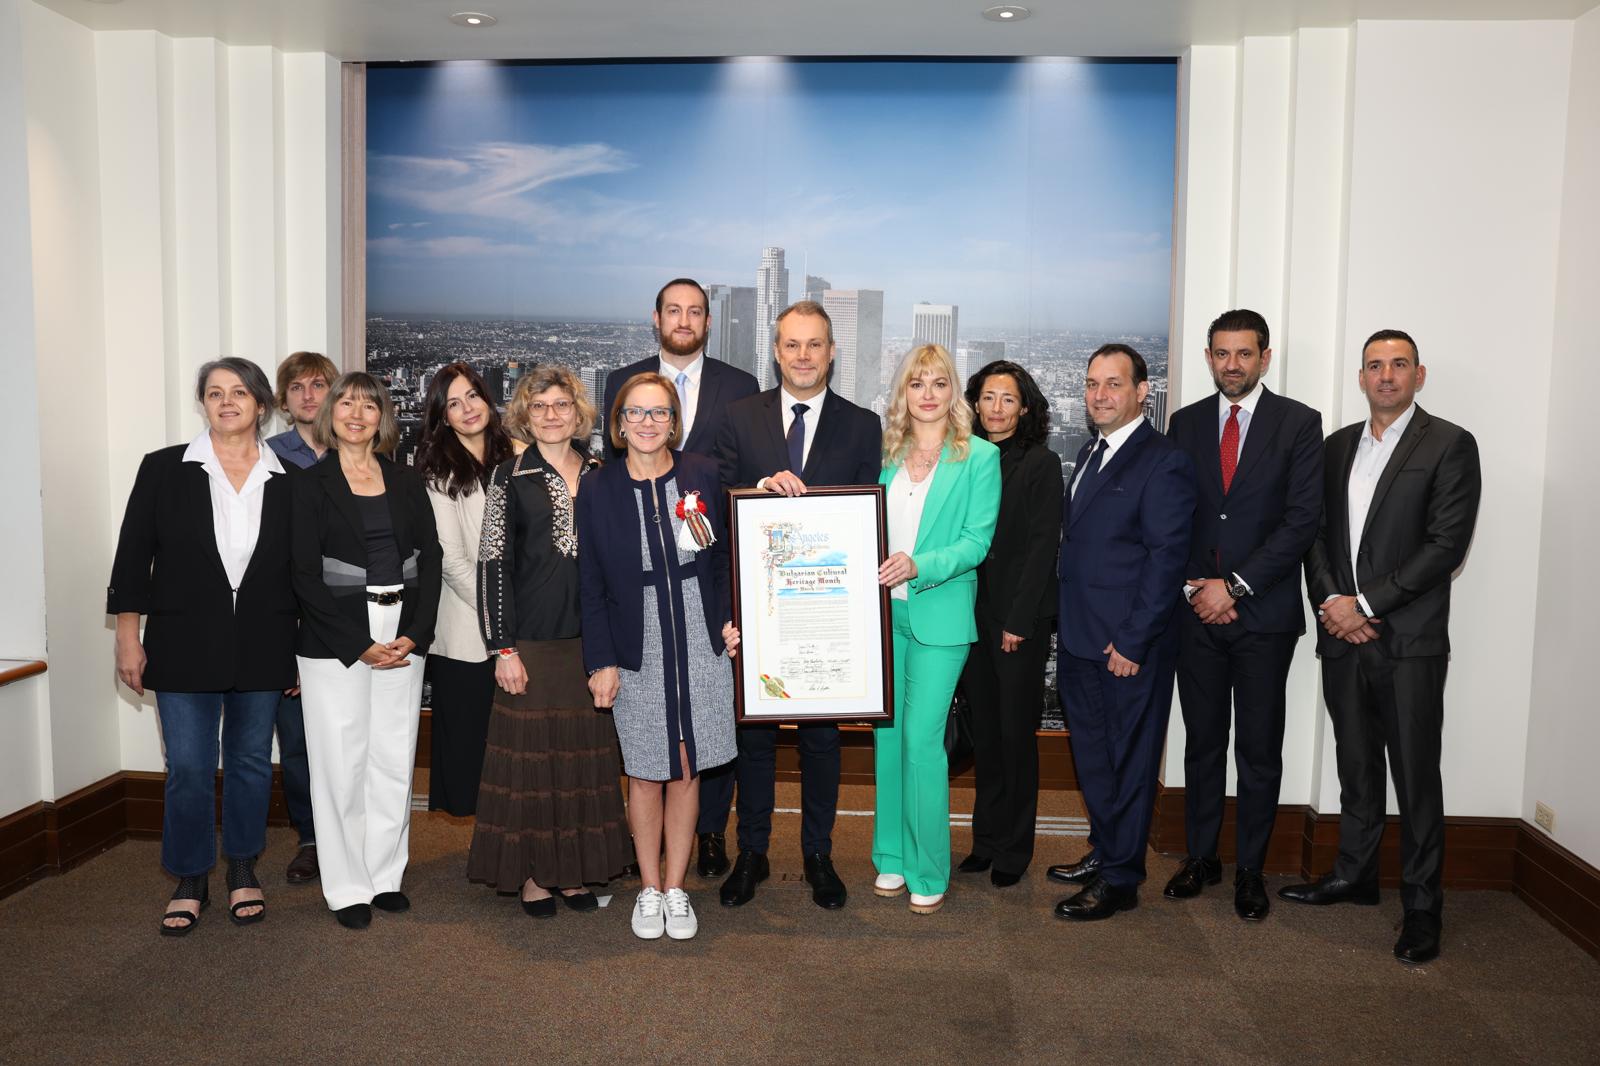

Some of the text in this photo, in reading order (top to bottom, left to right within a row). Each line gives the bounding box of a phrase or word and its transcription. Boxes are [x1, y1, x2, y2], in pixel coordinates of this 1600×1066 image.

[817, 568, 847, 576] Cultural
[786, 577, 841, 587] Heritage Month
